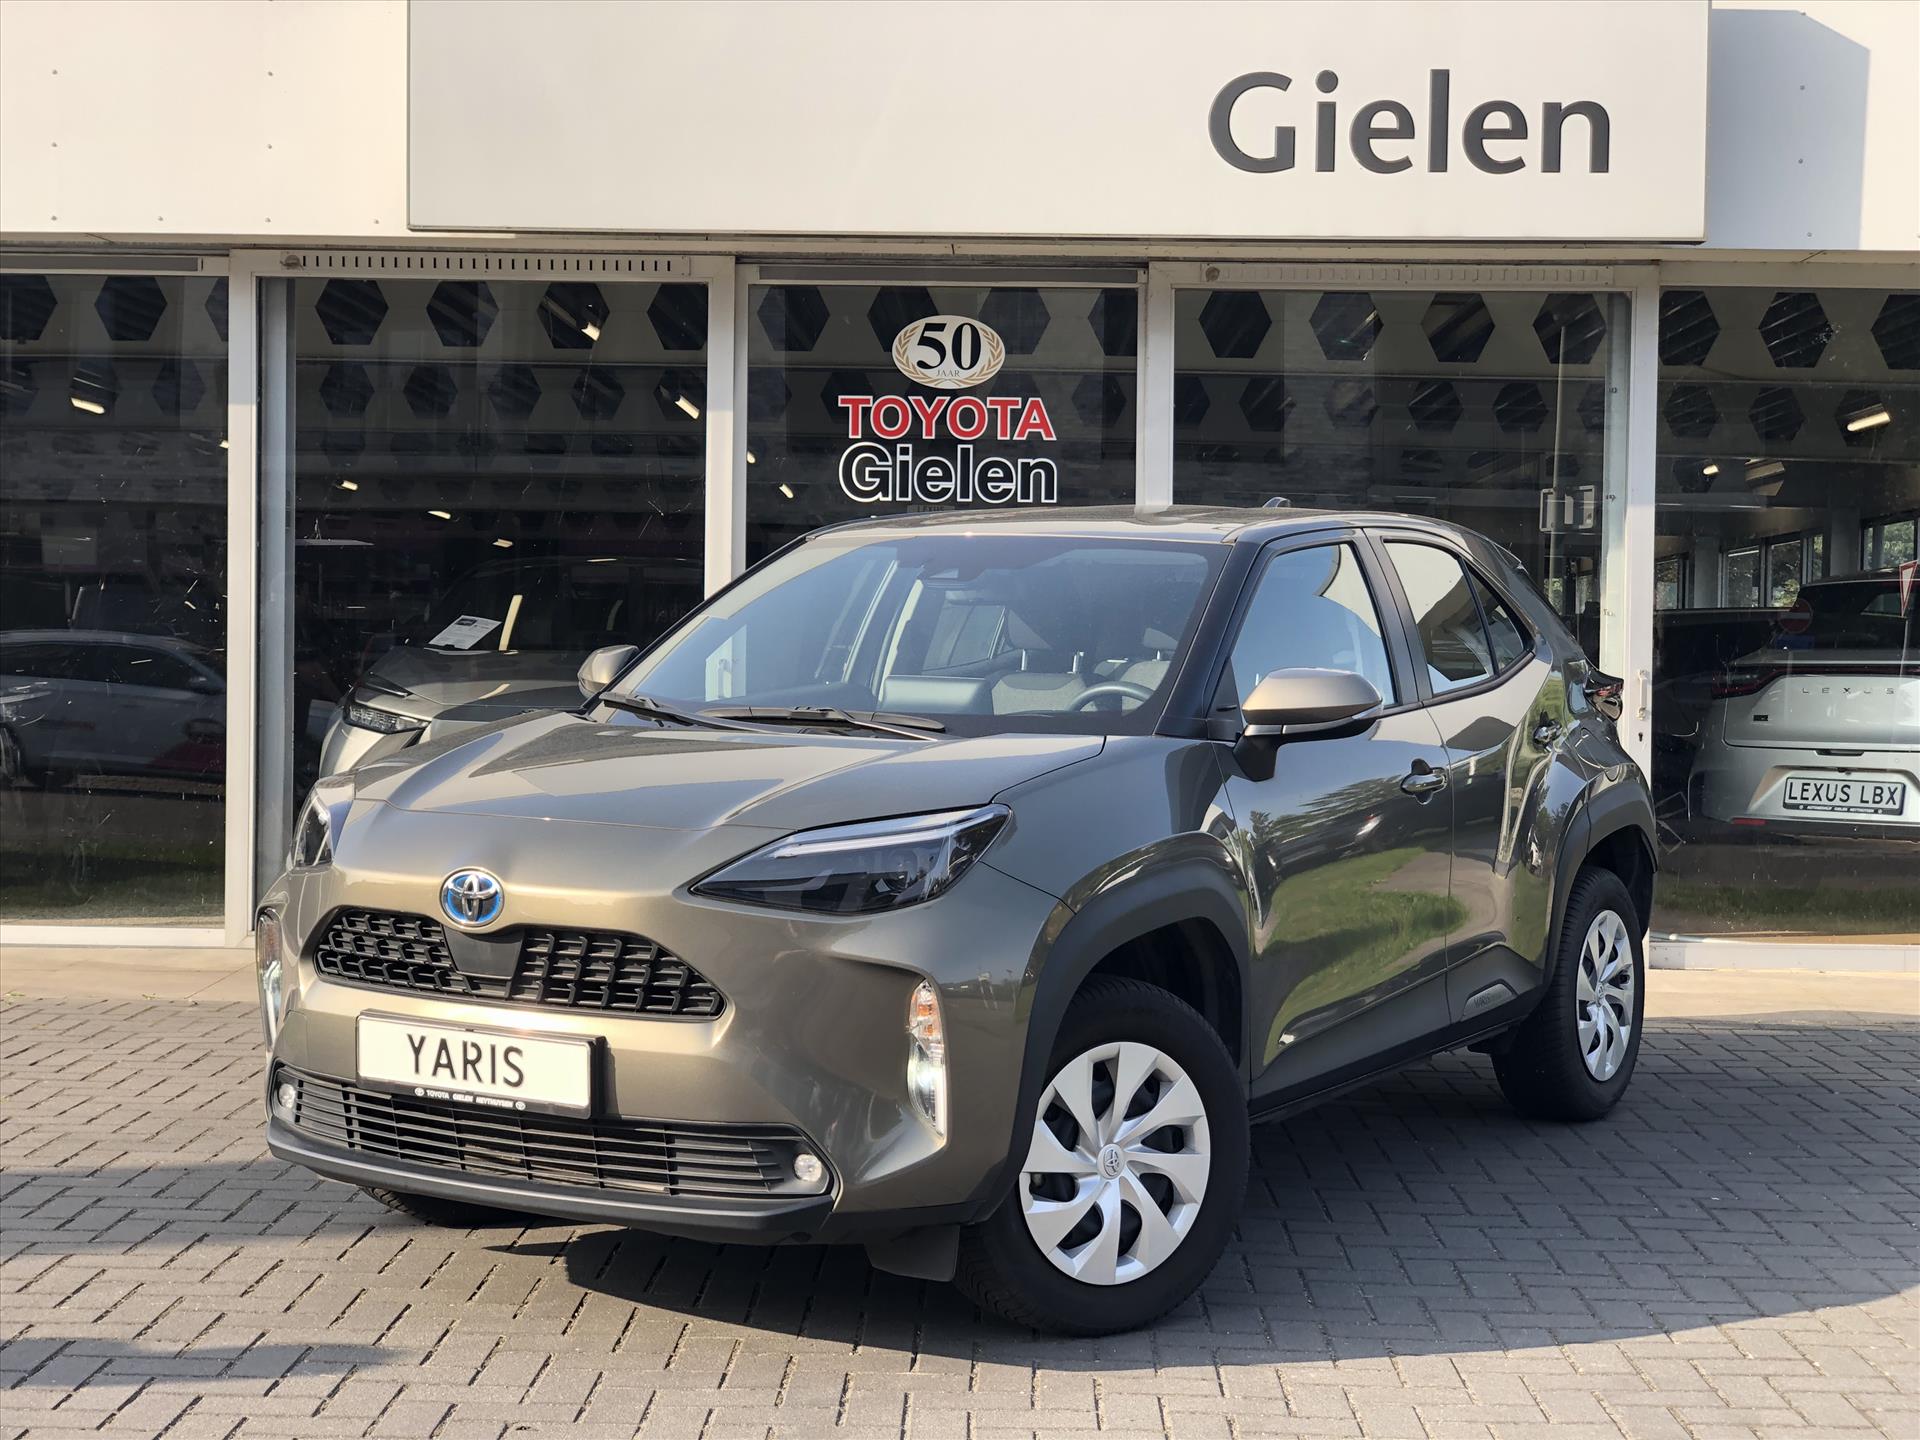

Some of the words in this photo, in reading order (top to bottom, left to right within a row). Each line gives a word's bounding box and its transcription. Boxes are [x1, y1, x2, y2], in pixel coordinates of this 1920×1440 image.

[1207, 68, 1611, 175] Gielen
[916, 322, 982, 370] 50
[936, 369, 961, 378] JAAR
[838, 395, 1058, 441] TOYOTA
[838, 441, 1058, 504] Gielen
[1801, 687, 1896, 695] LEXUS
[1788, 782, 1852, 803] LEXUS
[1859, 785, 1899, 806] LBX
[406, 1033, 525, 1088] YARIS
[426, 1089, 450, 1099] TOYOTA
